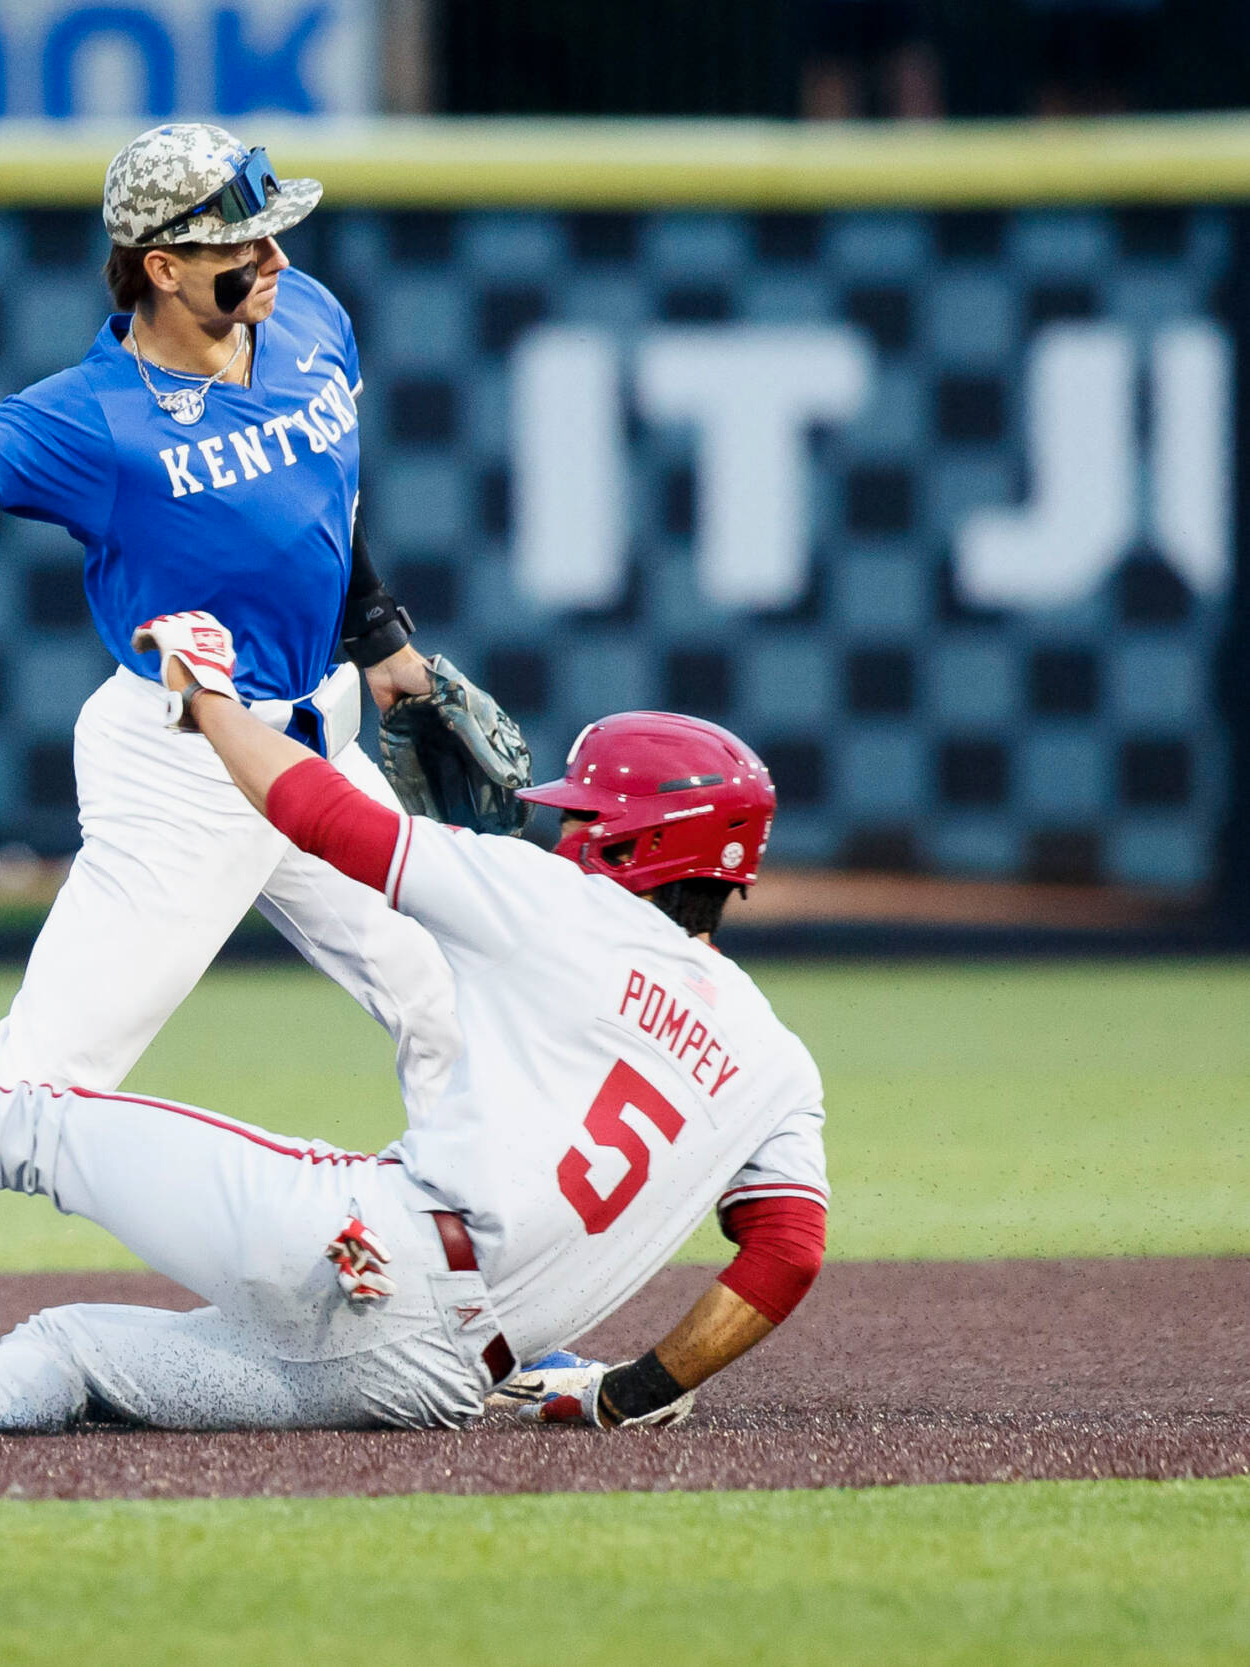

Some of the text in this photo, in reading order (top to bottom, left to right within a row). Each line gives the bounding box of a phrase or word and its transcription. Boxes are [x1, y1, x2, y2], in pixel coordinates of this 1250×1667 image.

[159, 366, 360, 498] KENTUCKY
[510, 322, 878, 609] IT
[619, 968, 740, 1098] POMPEY
[556, 1057, 687, 1236] 5
